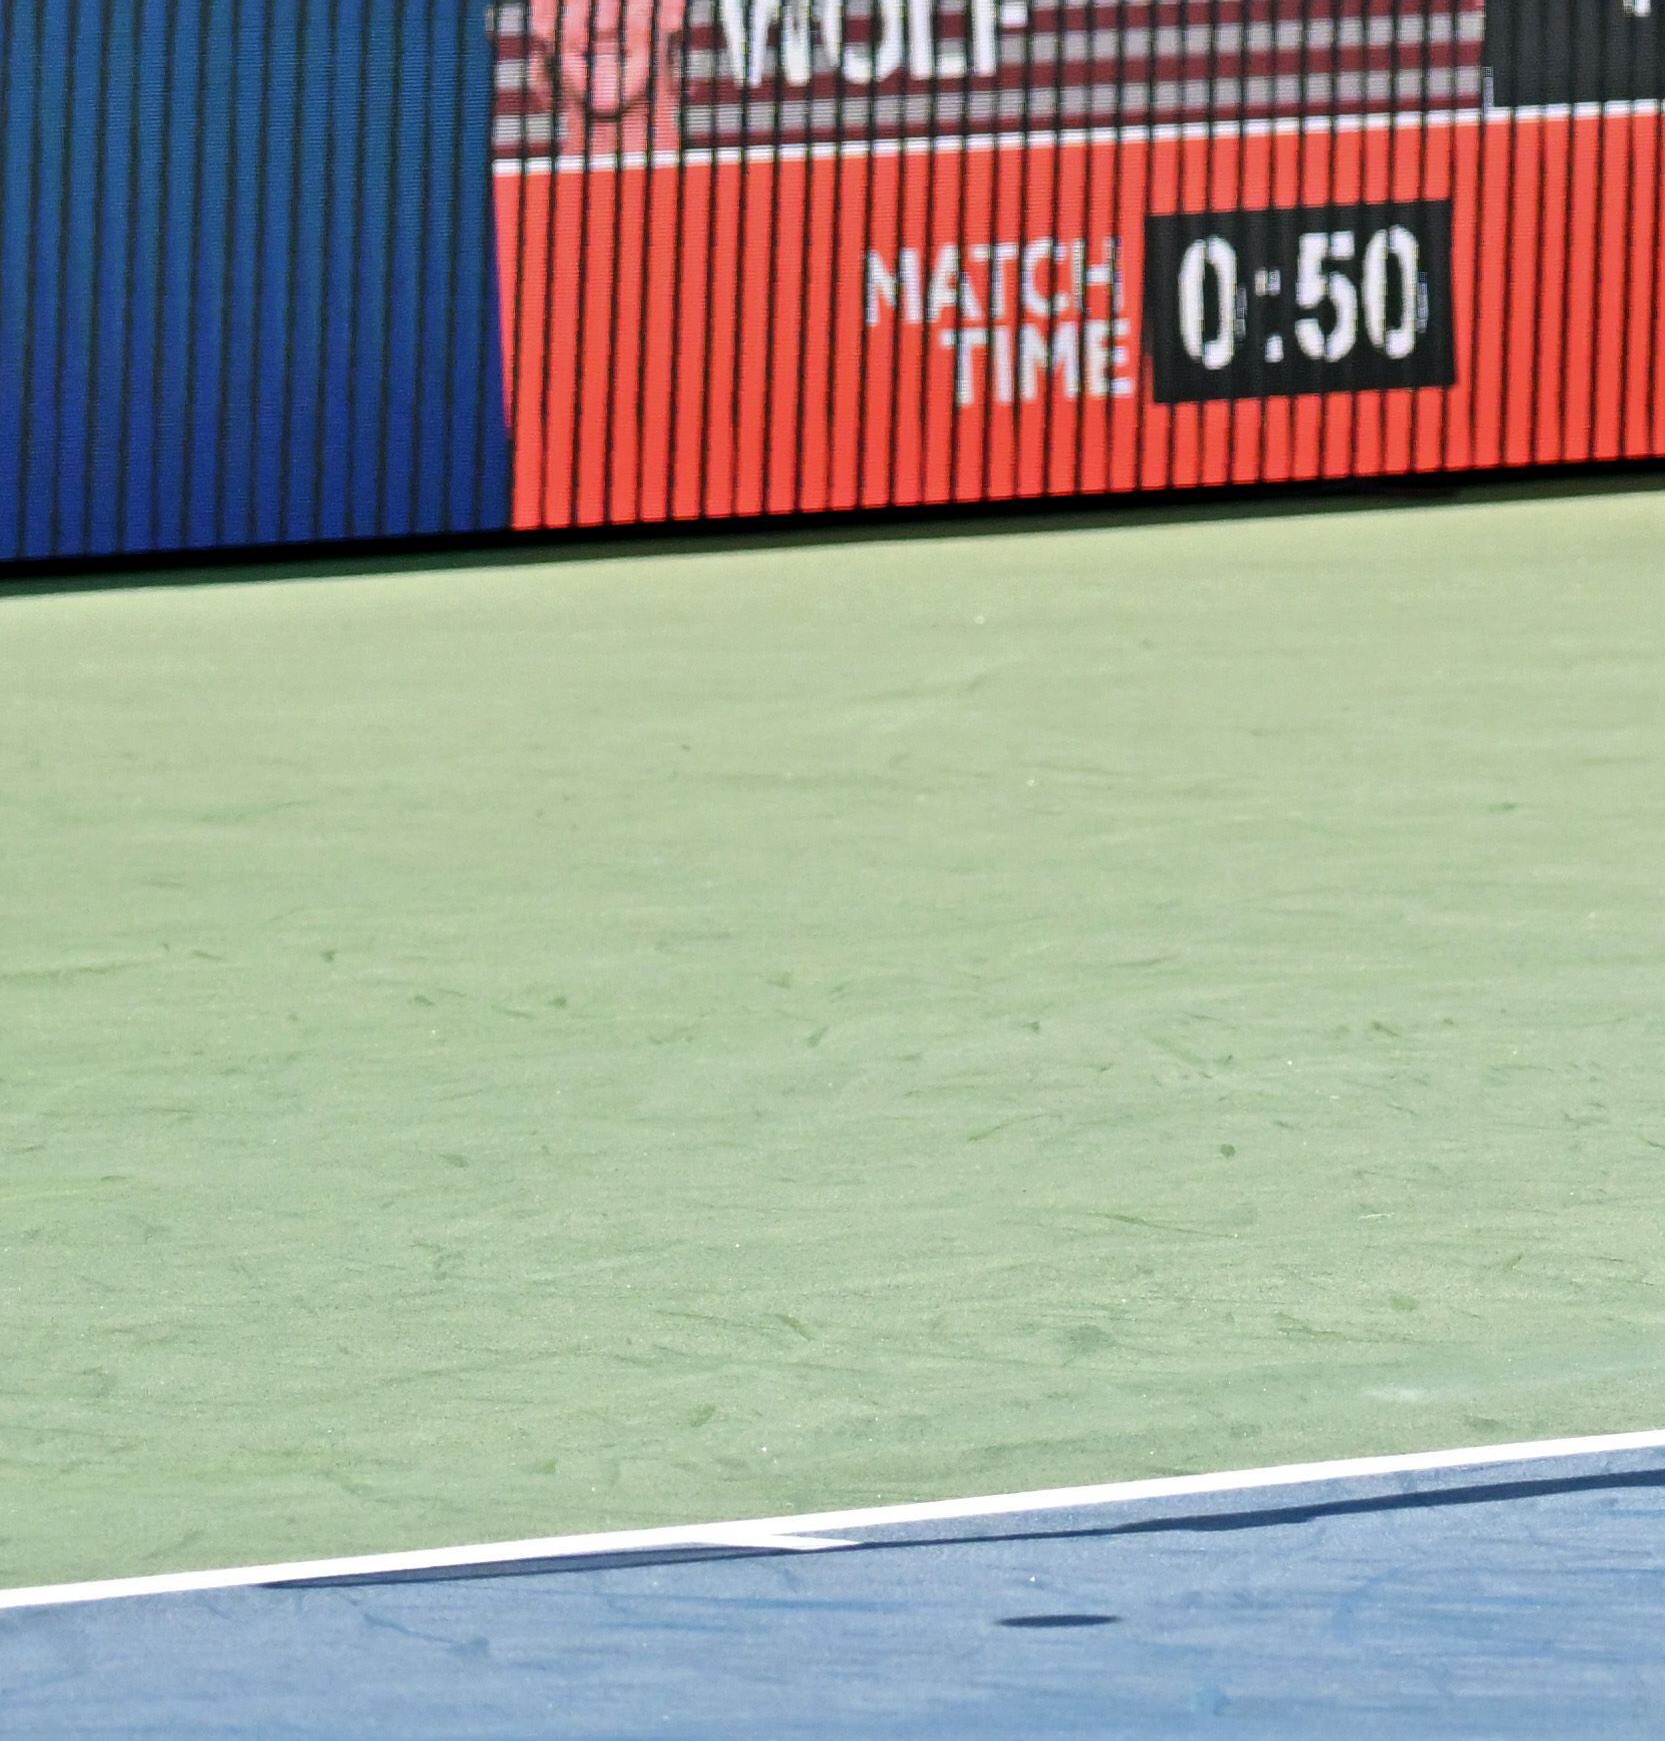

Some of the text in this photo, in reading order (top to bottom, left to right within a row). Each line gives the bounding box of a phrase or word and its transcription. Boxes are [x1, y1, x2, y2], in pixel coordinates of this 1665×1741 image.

[864, 236, 1123, 327] MATCH
[1178, 224, 1428, 371] 0:50
[938, 318, 1133, 407] TIME
